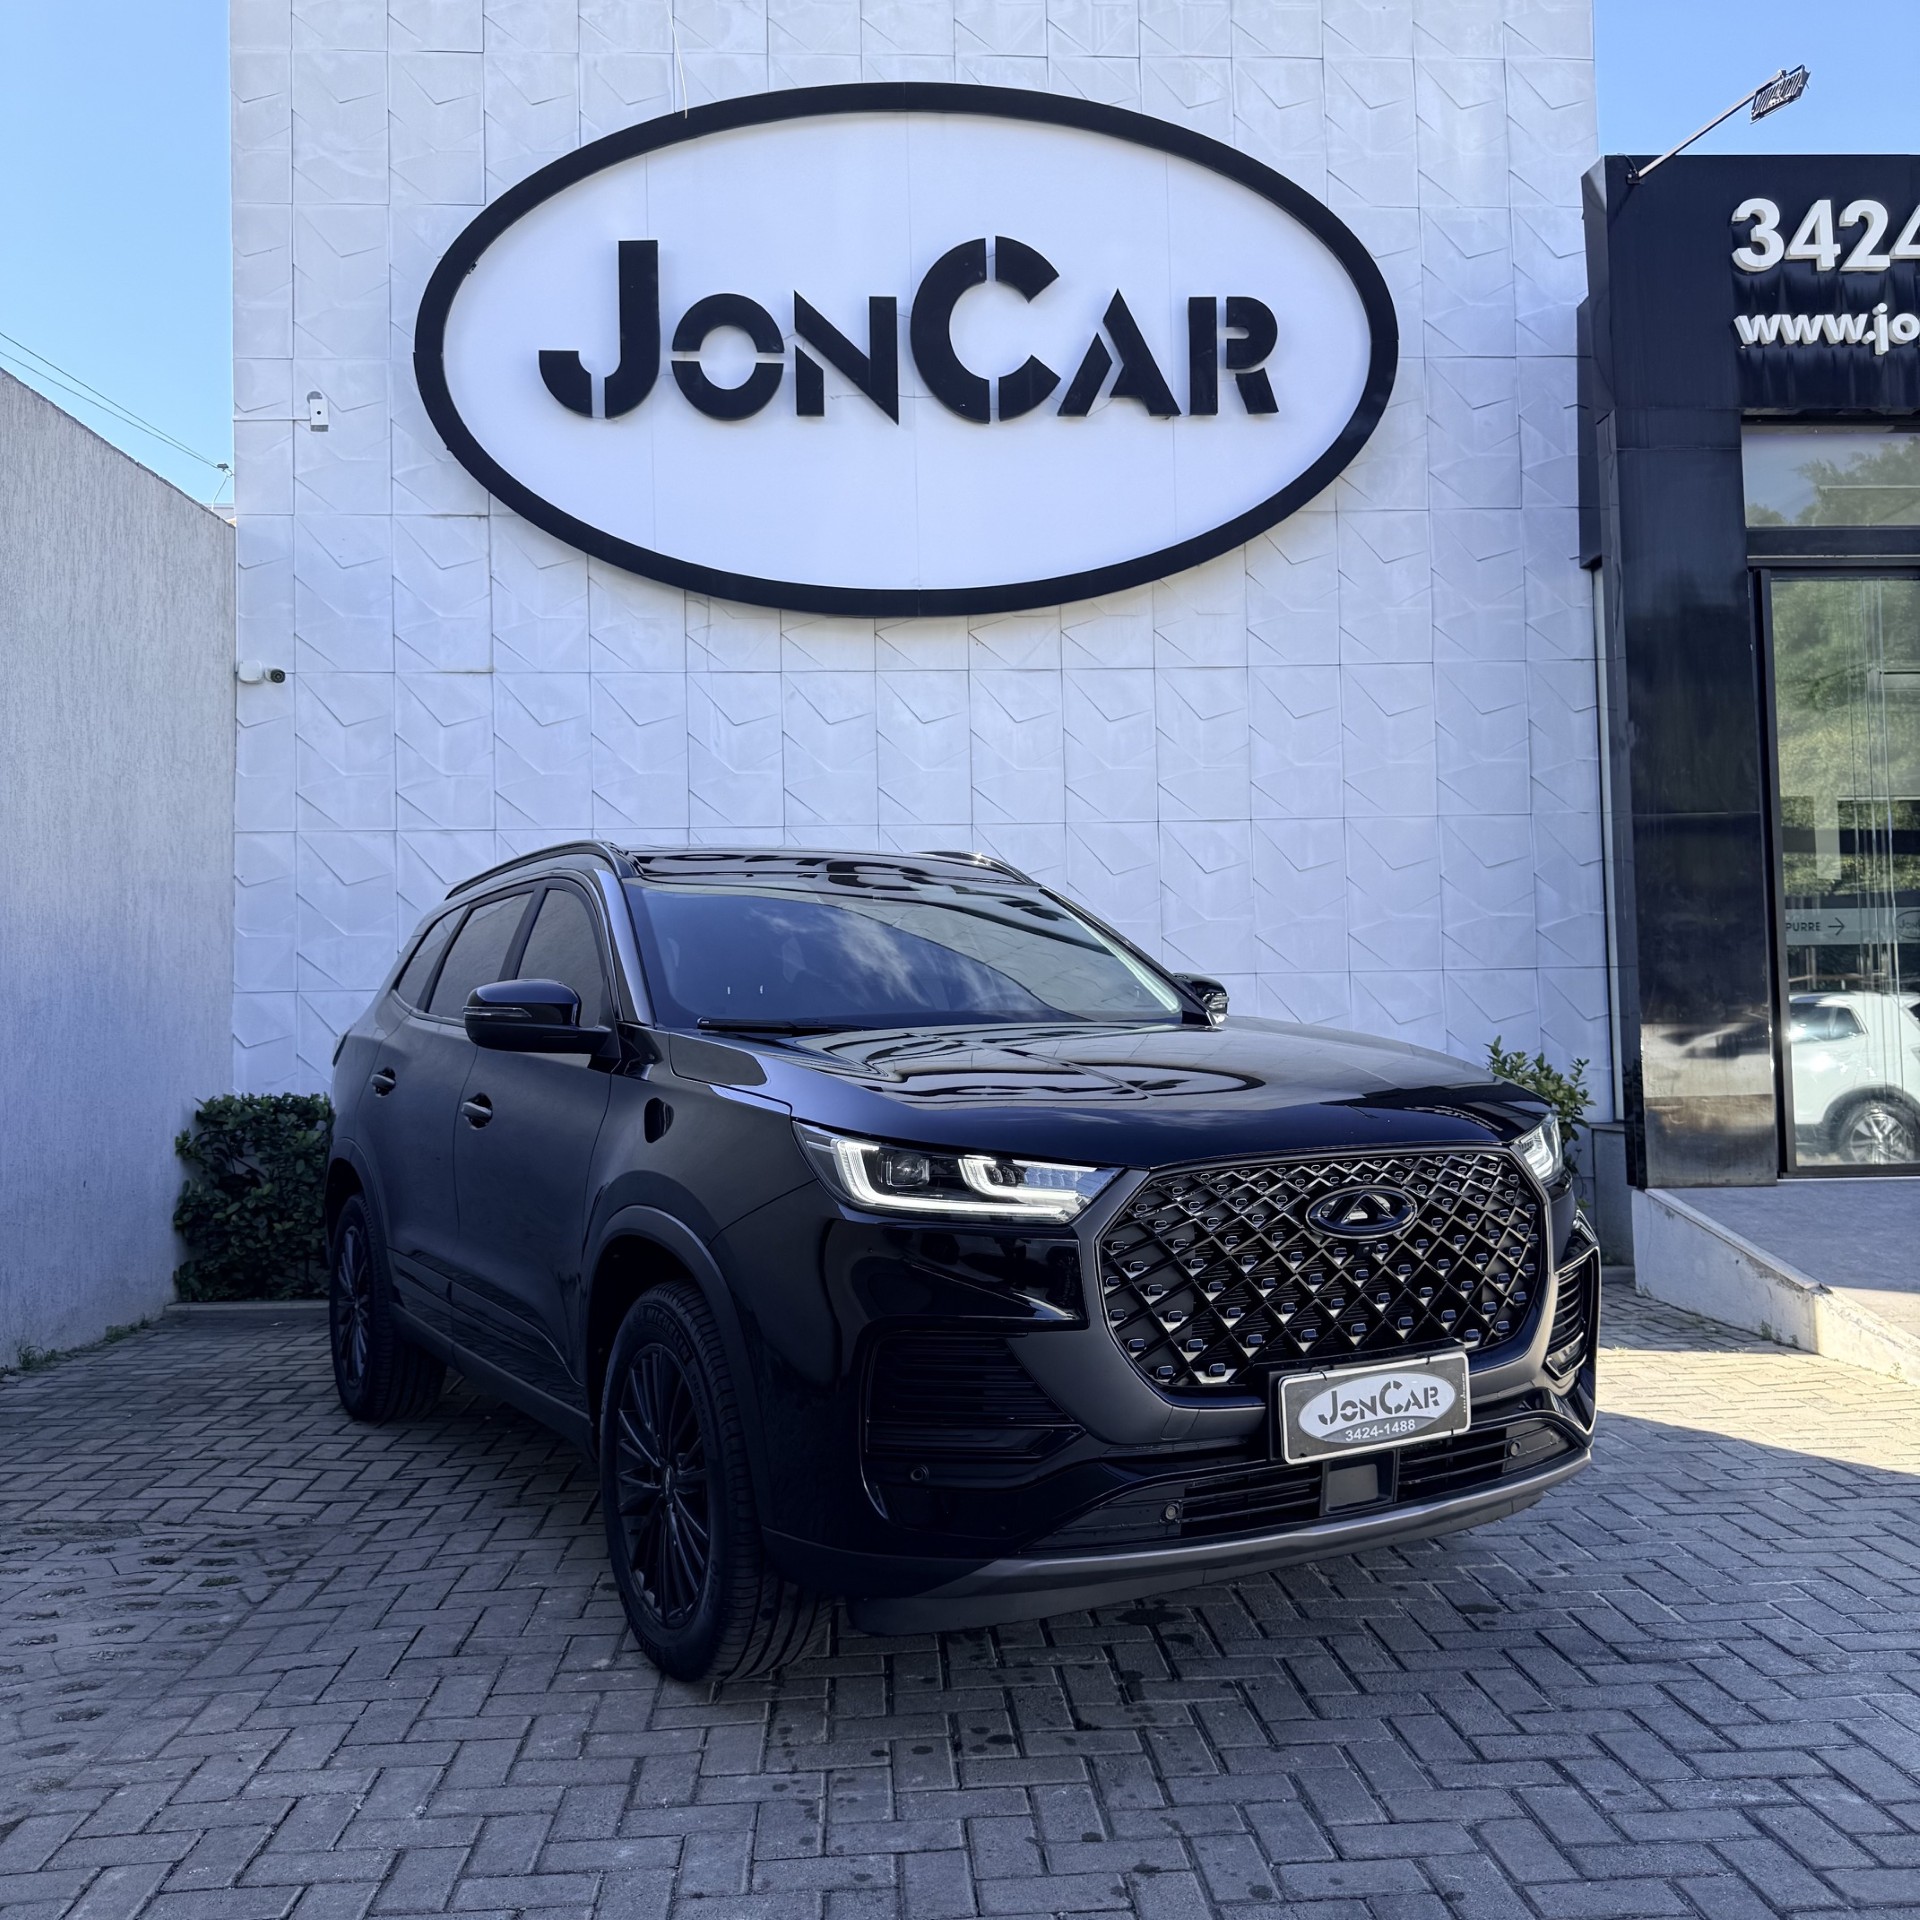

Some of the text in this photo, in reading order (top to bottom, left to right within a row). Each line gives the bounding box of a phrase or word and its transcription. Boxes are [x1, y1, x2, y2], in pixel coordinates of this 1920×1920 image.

[1733, 302, 1920, 355] www.jo
[646, 1306, 691, 1362] MICHELIN
[1345, 1419, 1416, 1442] 3424-1488
